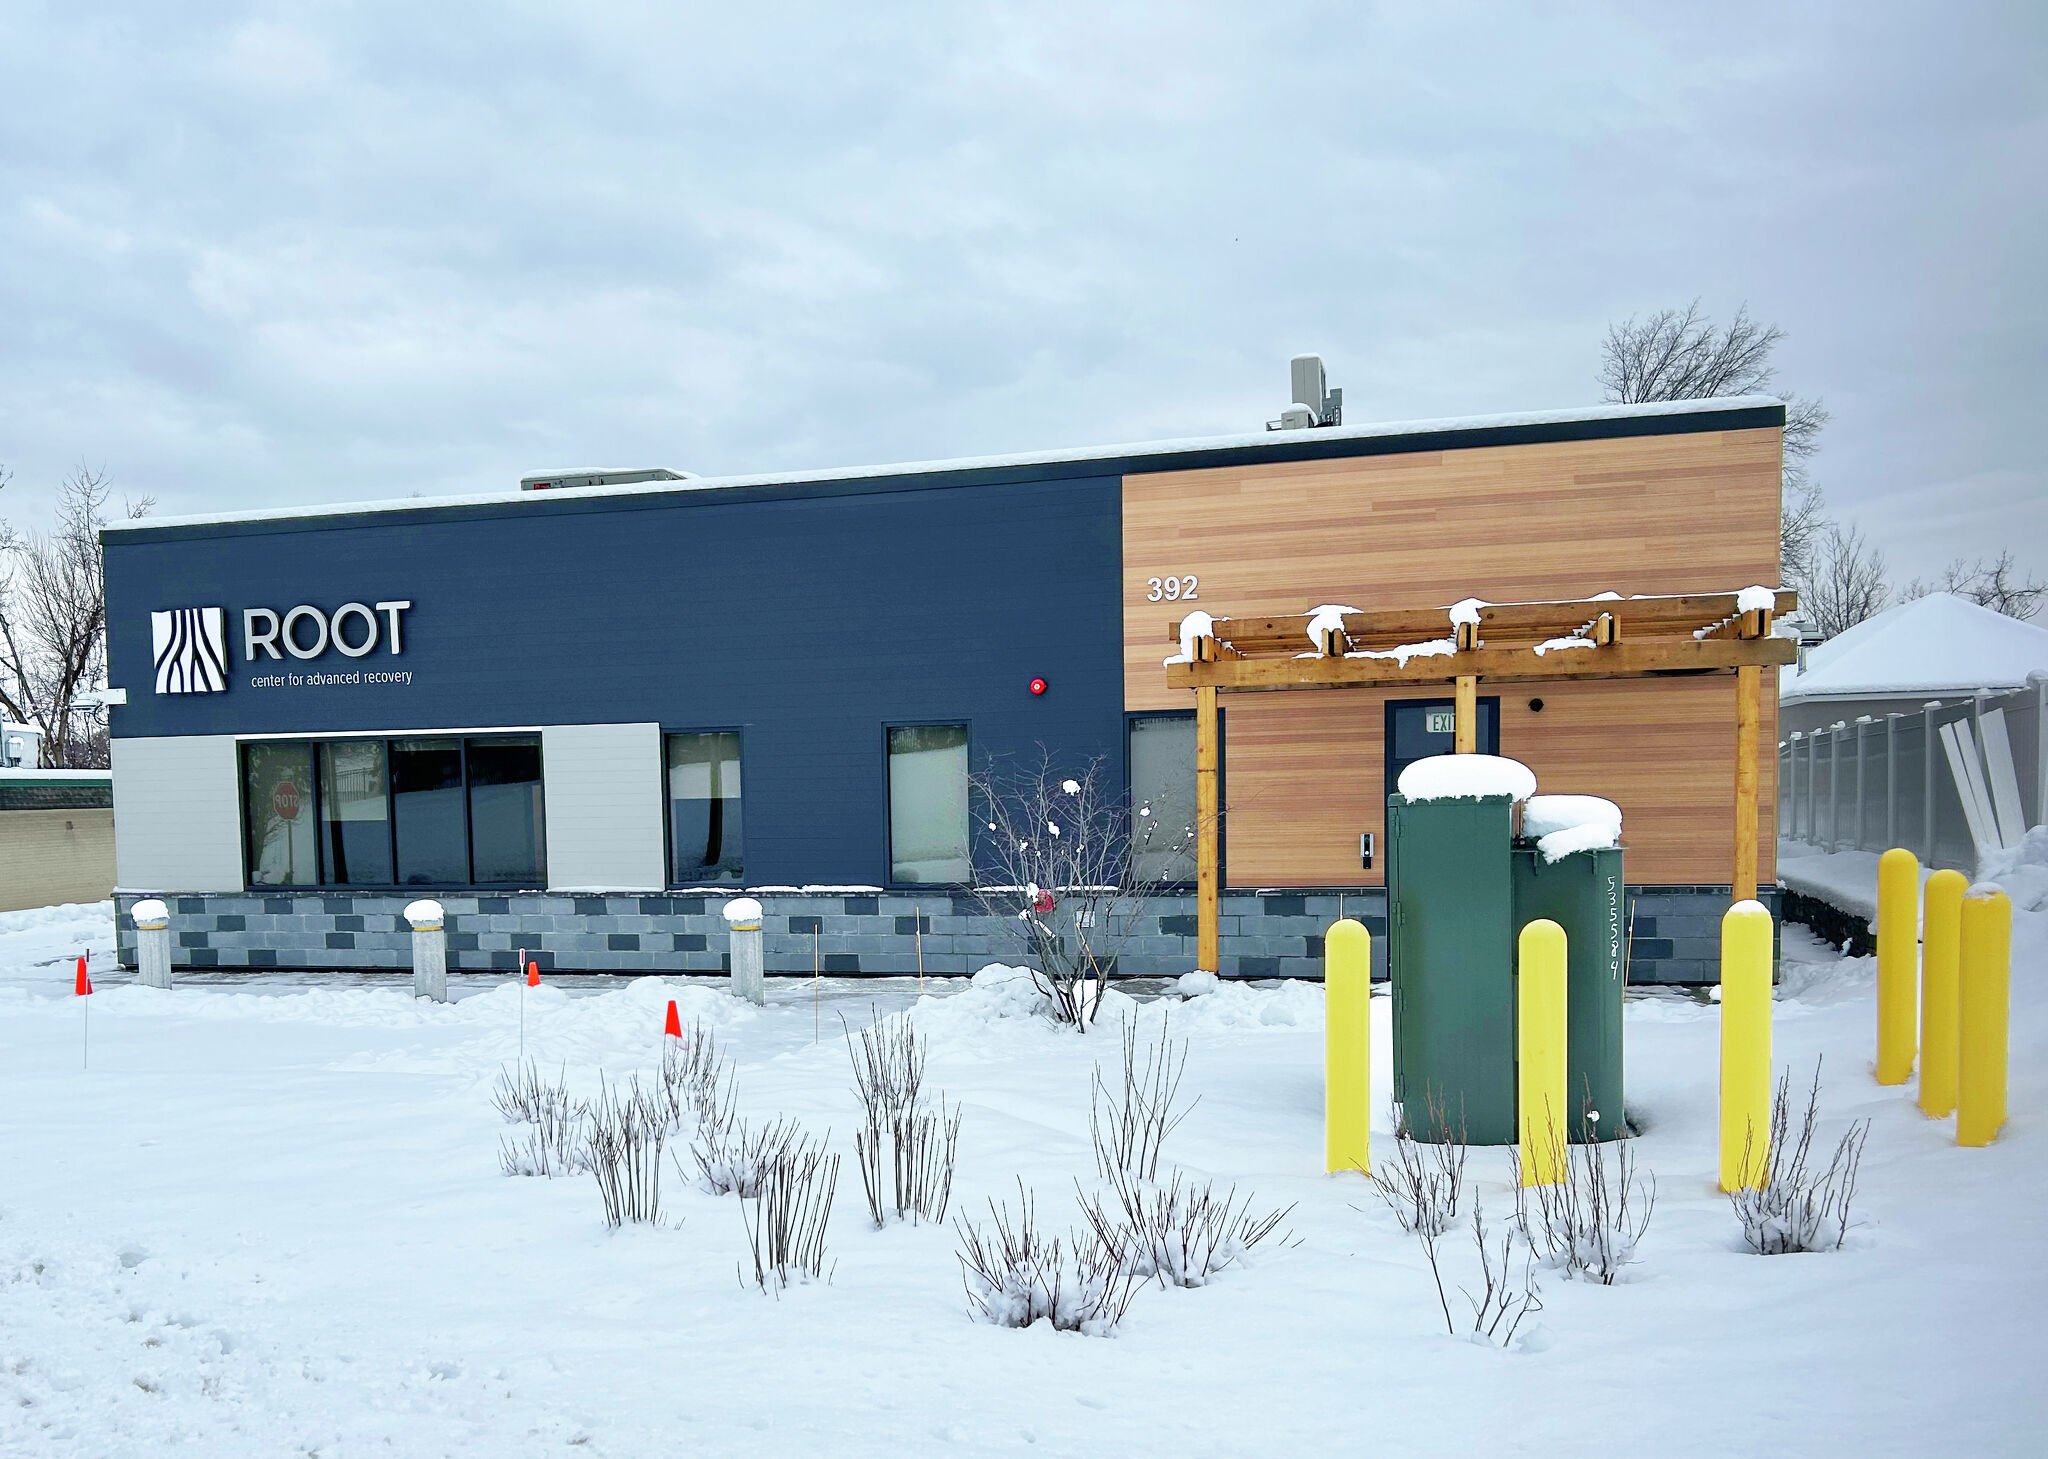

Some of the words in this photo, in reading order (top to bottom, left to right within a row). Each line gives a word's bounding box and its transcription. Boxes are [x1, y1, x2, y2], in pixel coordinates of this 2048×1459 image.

[1147, 575, 1198, 602] 392
[243, 600, 412, 661] ROOT
[251, 674, 286, 688] center
[288, 672, 304, 686] for
[306, 670, 360, 686] advanced
[363, 670, 413, 686] recovery
[1607, 875, 1619, 980] 535584
